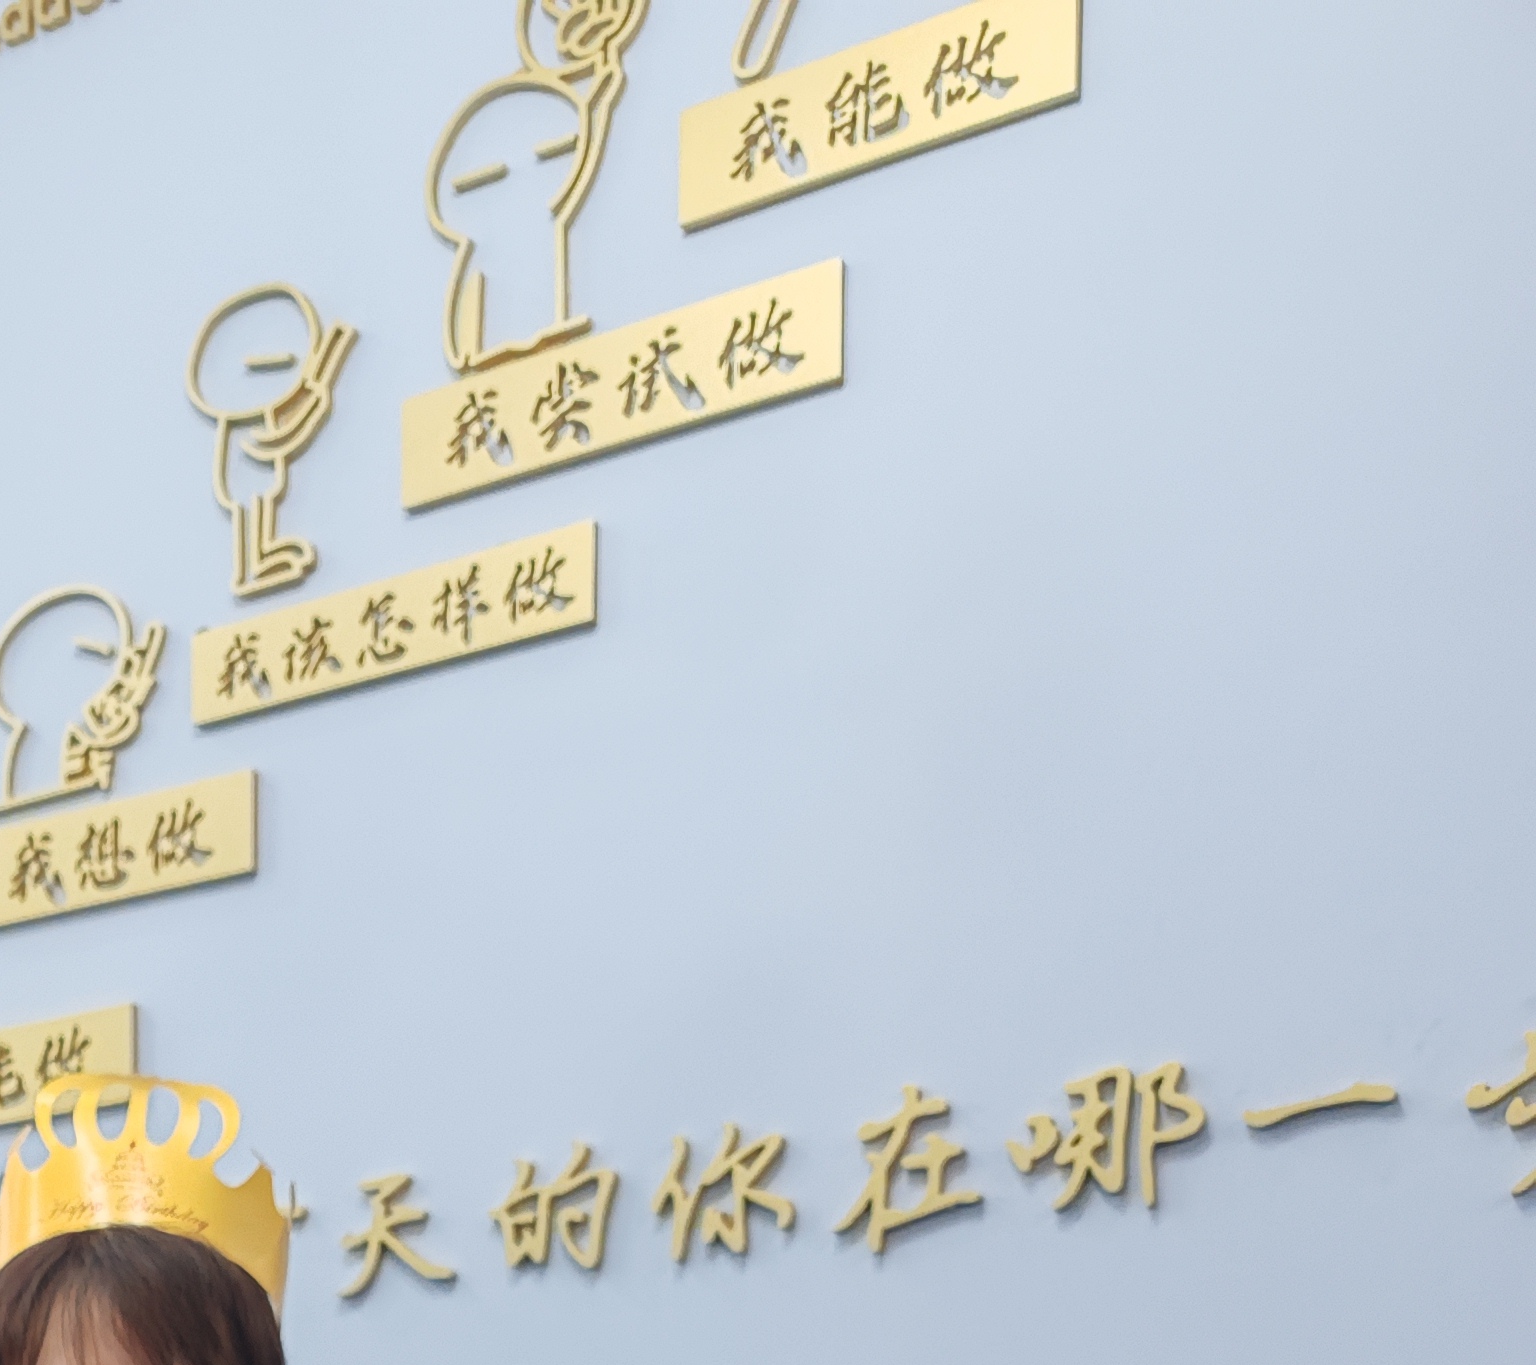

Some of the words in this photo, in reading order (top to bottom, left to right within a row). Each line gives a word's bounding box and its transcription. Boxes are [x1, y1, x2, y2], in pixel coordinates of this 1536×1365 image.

[729, 19, 1020, 182] 我能做
[445, 296, 806, 468] 我尝试做
[216, 545, 576, 699] 我该怎样做
[8, 798, 214, 907] 我想做
[279, 1031, 1536, 1300] 天的你在哪一
